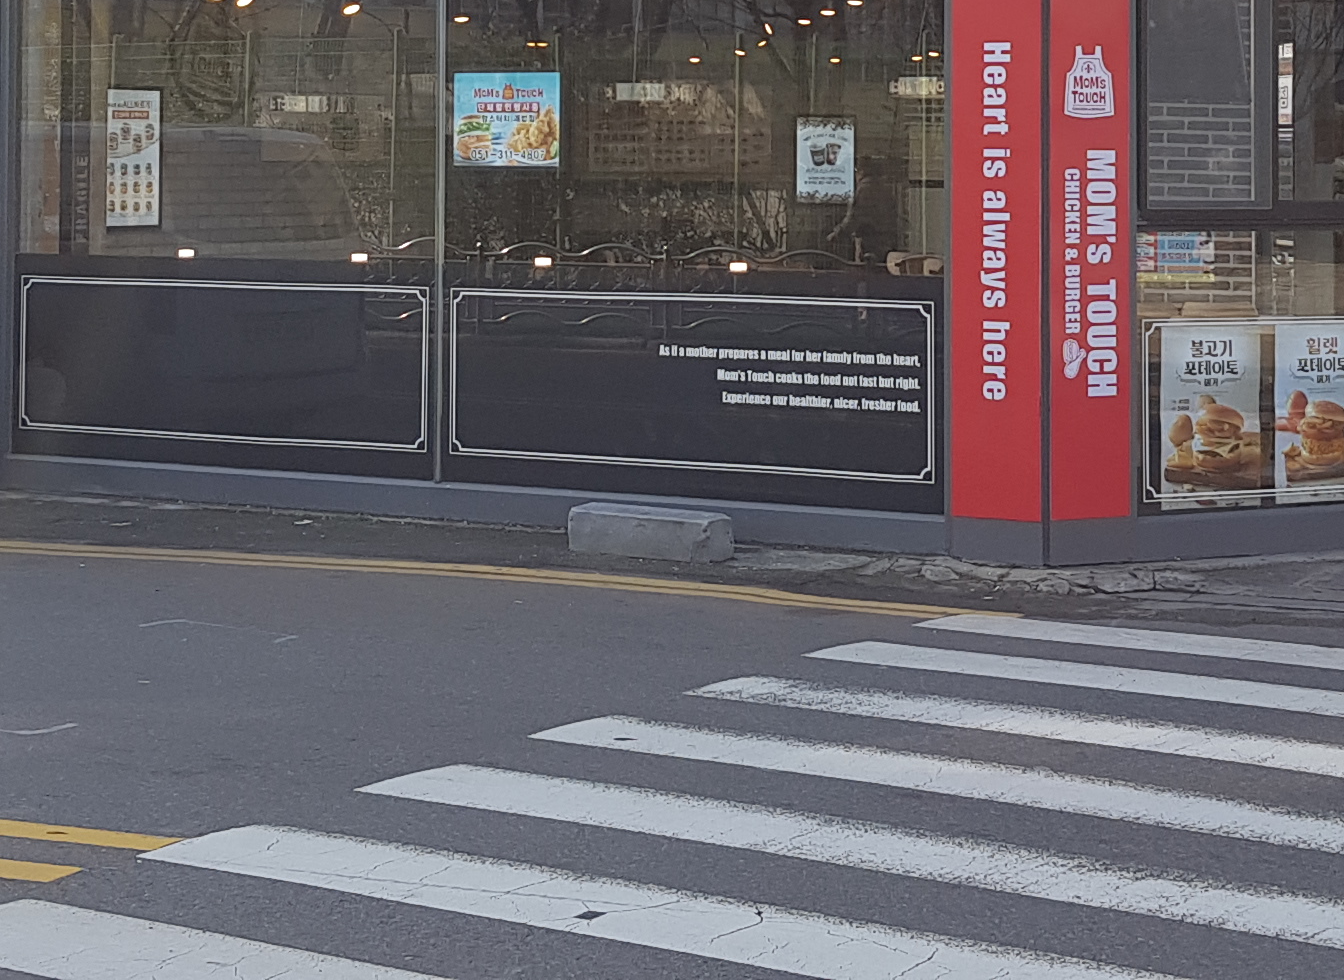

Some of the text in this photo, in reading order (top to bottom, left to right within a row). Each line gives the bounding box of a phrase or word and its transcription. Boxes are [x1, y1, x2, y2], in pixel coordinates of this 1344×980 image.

[1071, 90, 1107, 105] TOUCH
[471, 149, 545, 160] 051-311-4807
[982, 41, 1011, 402] Heart is always here
[1064, 168, 1081, 335] CHICKEN & BURGER
[1086, 149, 1118, 398] MOM'S TOUCH
[686, 347, 717, 358] mother
[719, 348, 759, 360] prepares
[768, 350, 790, 361] meal
[792, 350, 804, 362] for
[806, 351, 821, 362] her
[823, 351, 852, 365] family
[853, 352, 874, 364] from
[876, 353, 891, 365] the
[1190, 339, 1233, 358] 불고기
[1184, 360, 1239, 376] 포테이토
[717, 369, 745, 381] Mom's
[747, 370, 774, 382] Touch
[776, 371, 802, 384] cooks
[804, 372, 819, 384] the
[820, 373, 841, 385] food
[843, 374, 858, 386] not
[859, 375, 877, 387] fast
[879, 376, 894, 388] but
[722, 391, 921, 412] Experience our healthier, nicer, fresher food.
